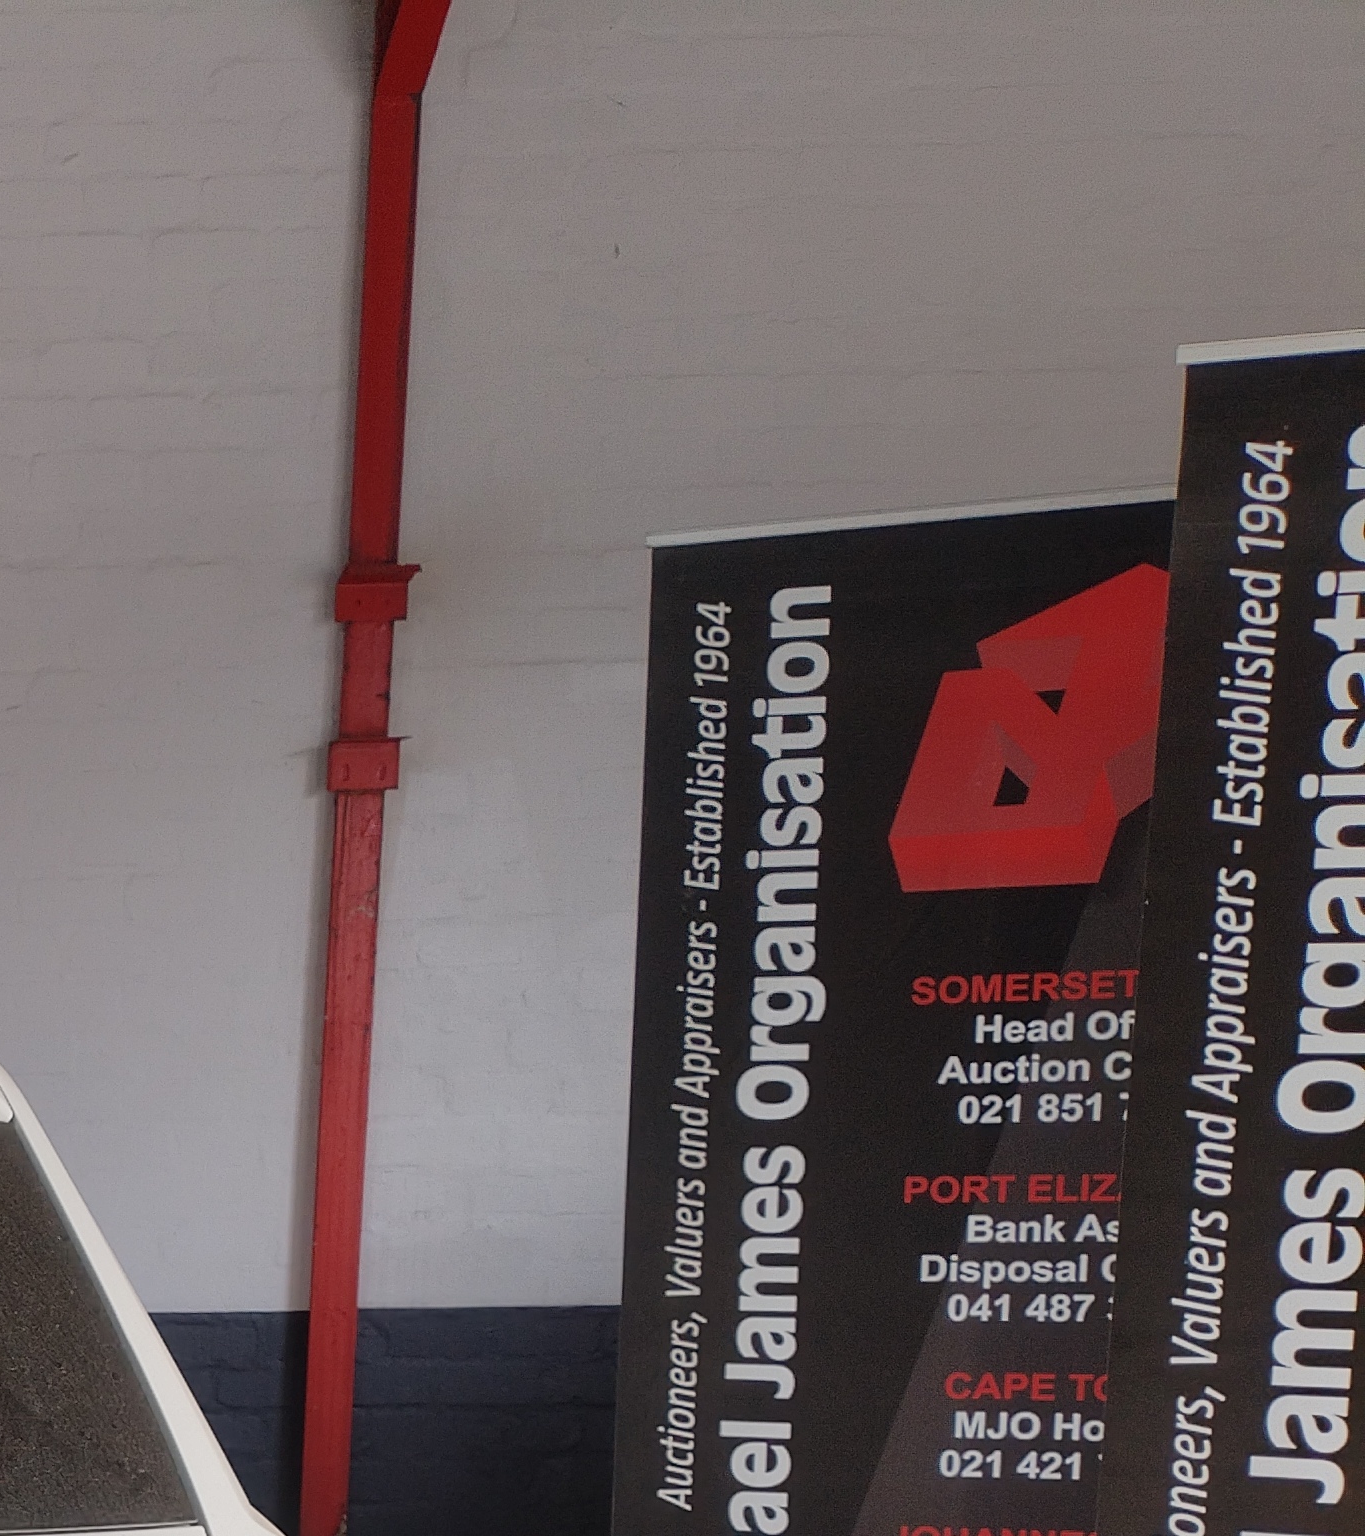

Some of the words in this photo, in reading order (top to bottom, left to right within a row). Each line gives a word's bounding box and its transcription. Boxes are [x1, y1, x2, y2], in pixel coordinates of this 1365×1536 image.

[1237, 440, 1294, 554] 1964
[693, 601, 732, 687] 1964
[1212, 567, 1282, 827] Established
[683, 696, 728, 891] Established
[1276, 424, 1365, 1134] Organisati
[735, 585, 832, 1121] Organisation
[674, 920, 721, 1099] Appraisers
[911, 968, 1140, 1006] SOMERSET
[975, 1011, 1075, 1044] Head
[1191, 867, 1257, 1104] Appraisers
[937, 1053, 1091, 1085] Auction
[958, 1093, 1022, 1125] 021
[1037, 1092, 1102, 1123] 851
[670, 1103, 709, 1170] and
[1185, 1109, 1237, 1197] and
[903, 1174, 1016, 1204] PORT
[1027, 1173, 1122, 1203] ELIZ
[966, 1213, 1066, 1244] Bank
[664, 1177, 706, 1297] Valuers
[724, 1145, 806, 1400] James
[920, 1253, 1089, 1290] Disposal
[947, 1293, 1011, 1322] 041
[1024, 1293, 1096, 1323] 487
[1169, 1208, 1229, 1365] Valuers
[1248, 1168, 1365, 1505] James
[656, 1312, 708, 1511] Auctioneers,
[944, 1371, 1056, 1401] CAPE
[954, 1410, 1041, 1440] MJO
[939, 1449, 1002, 1479] 021
[1015, 1450, 1082, 1481] 421
